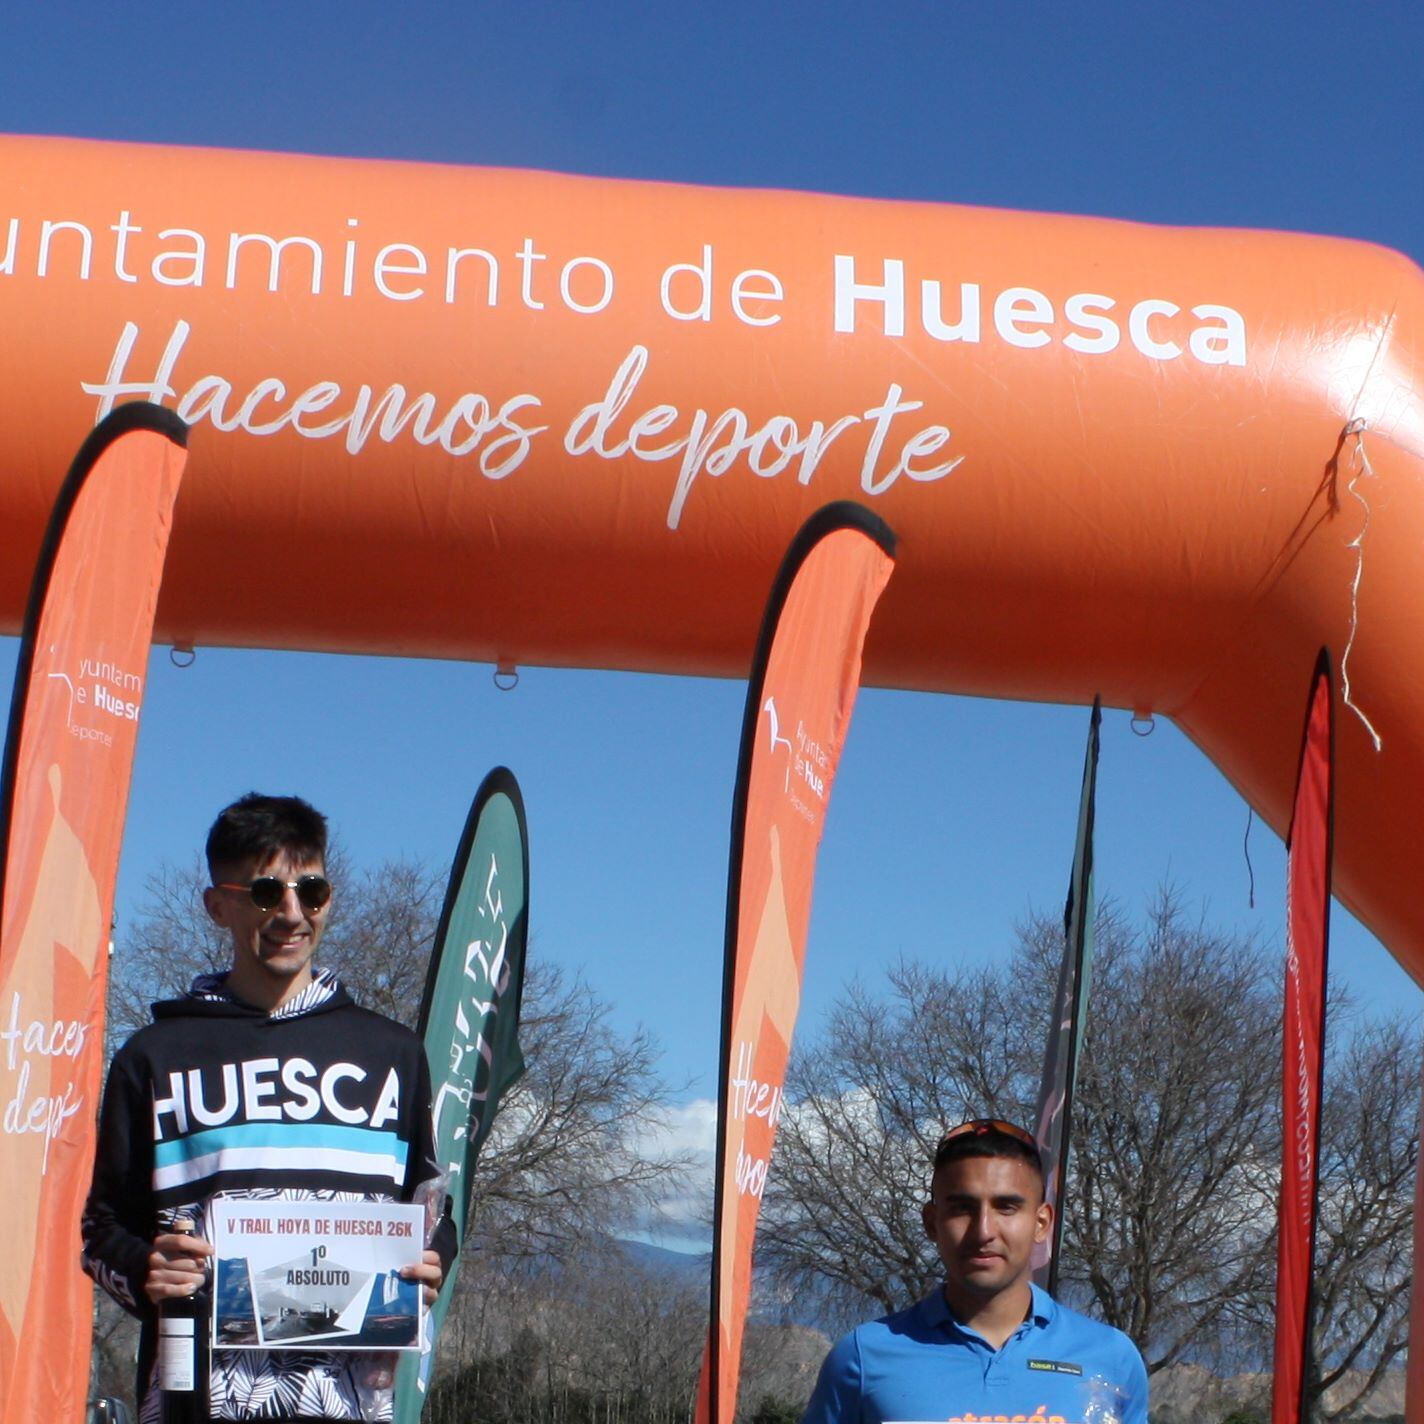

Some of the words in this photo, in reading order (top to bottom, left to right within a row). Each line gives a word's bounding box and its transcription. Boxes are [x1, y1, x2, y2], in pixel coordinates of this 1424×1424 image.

[661, 245, 784, 326] de
[834, 255, 1246, 366] Huesca
[81, 319, 548, 480] Hacemos
[564, 345, 965, 529] deporte
[153, 1058, 399, 1140] HUESCA
[227, 1218, 236, 1234] V
[240, 1218, 273, 1235] TRAIL
[278, 1219, 310, 1235] HOYA
[315, 1219, 330, 1235] DE
[334, 1219, 383, 1236] HUESCA
[387, 1220, 412, 1237] 26K
[287, 1270, 350, 1286] ABSOLUTO
